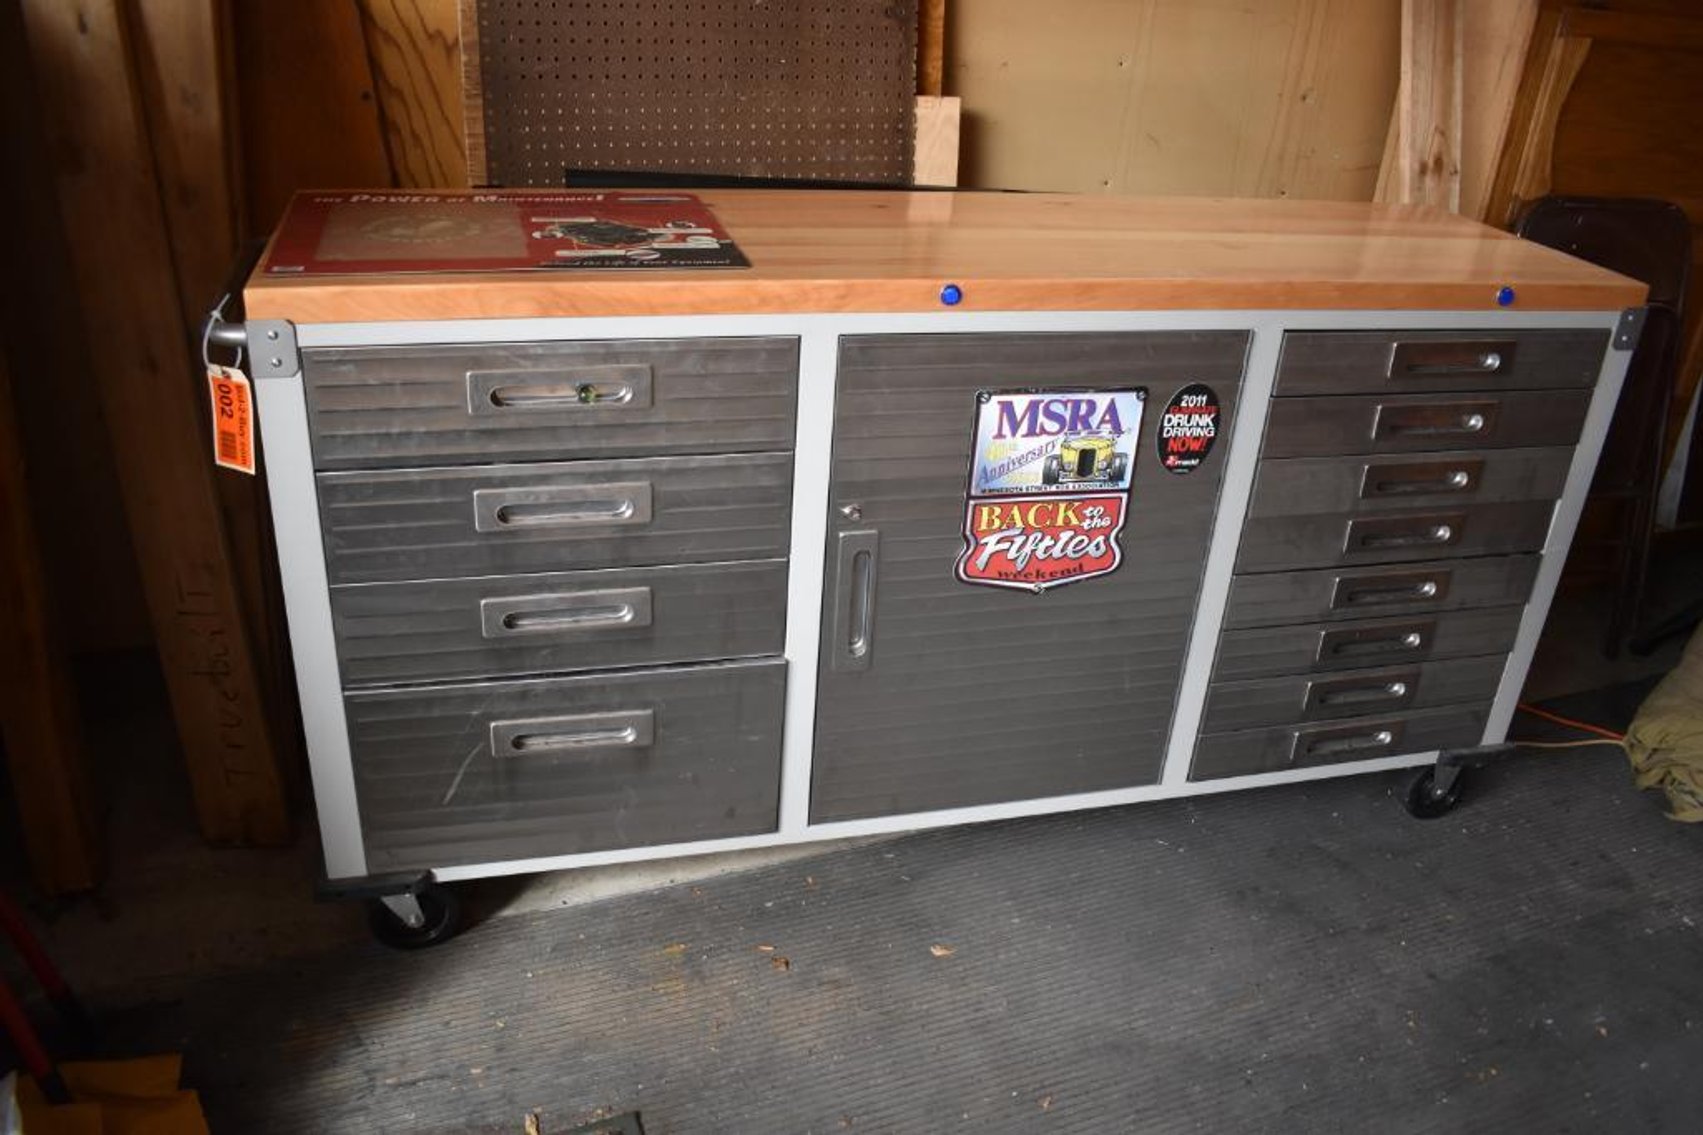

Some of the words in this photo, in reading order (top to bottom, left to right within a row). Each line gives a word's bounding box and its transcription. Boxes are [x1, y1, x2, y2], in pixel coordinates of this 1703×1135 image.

[217, 383, 234, 419] 002
[1180, 394, 1207, 407] 2011
[992, 397, 1126, 439] MSRA
[1163, 414, 1216, 427] DRUNK
[1162, 426, 1215, 438] DRIVING
[1168, 437, 1209, 453] NOW!
[979, 437, 1060, 485] Anniversary
[978, 501, 1083, 532] BACK
[1083, 506, 1104, 519] to
[1081, 516, 1112, 530] the
[975, 528, 1107, 571] Fifties
[997, 563, 1084, 580] weekend
